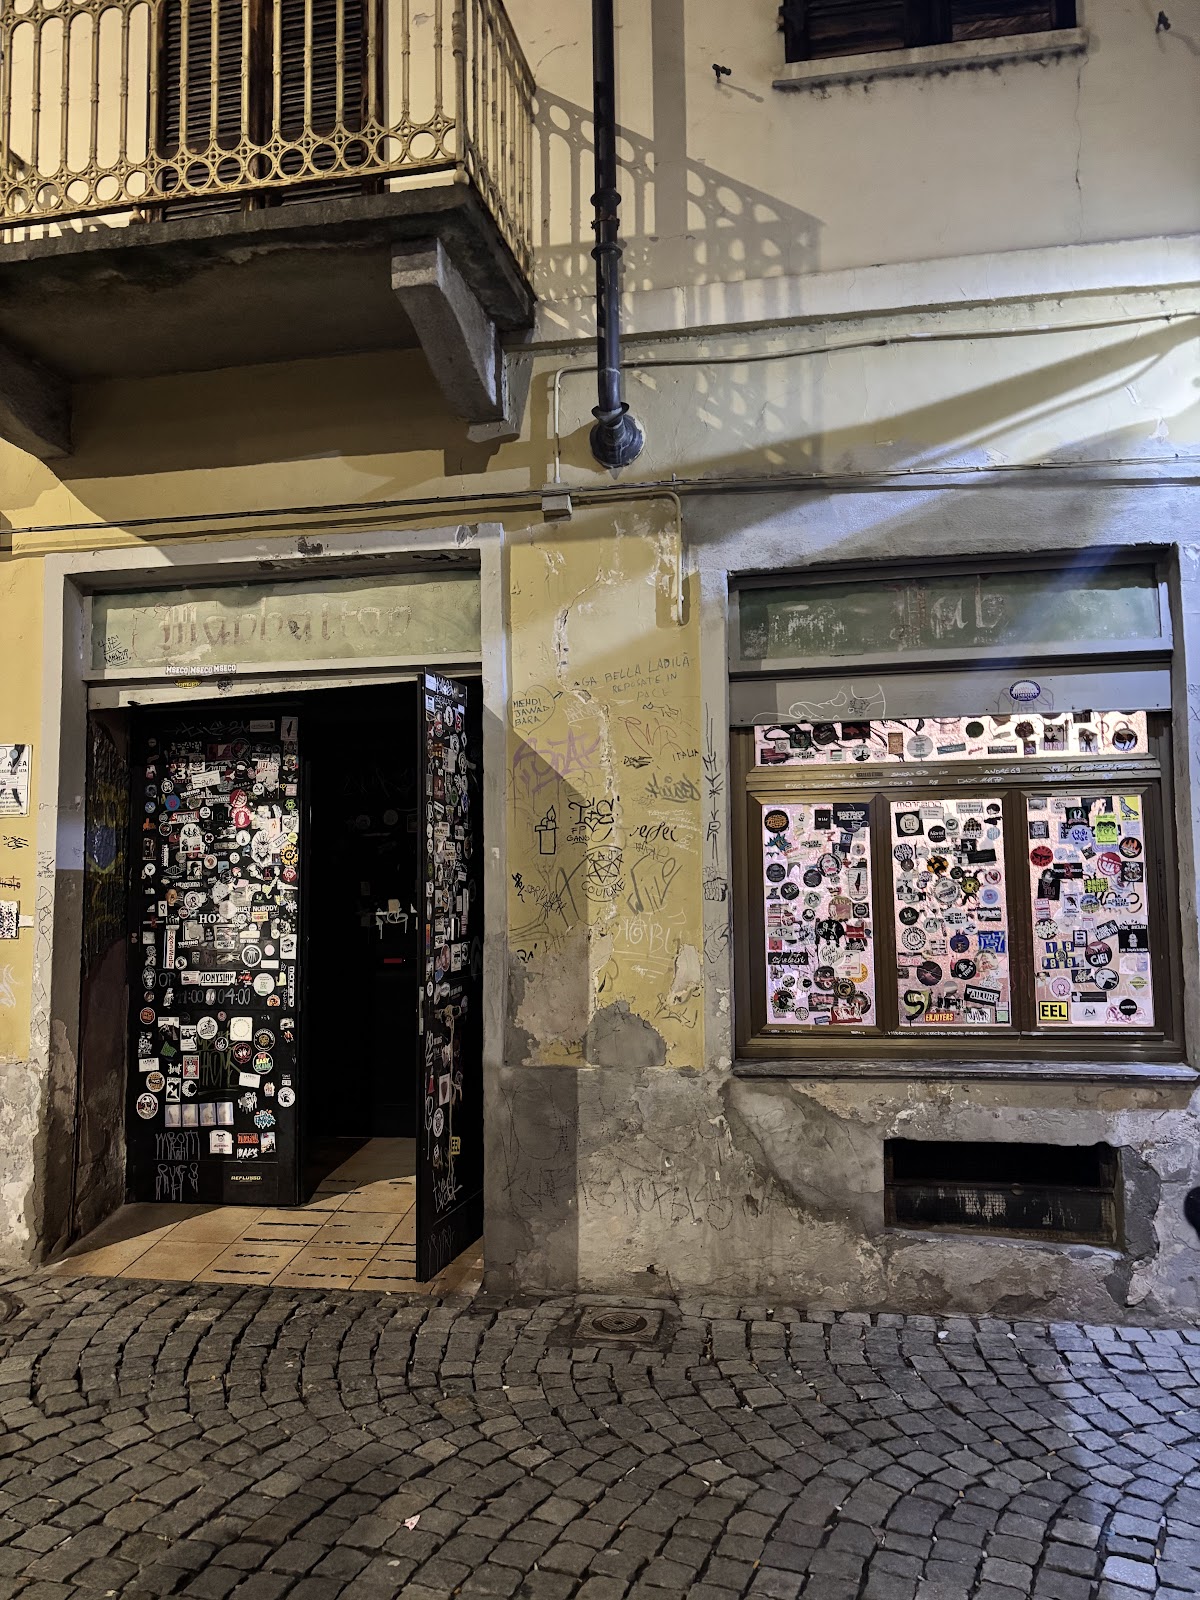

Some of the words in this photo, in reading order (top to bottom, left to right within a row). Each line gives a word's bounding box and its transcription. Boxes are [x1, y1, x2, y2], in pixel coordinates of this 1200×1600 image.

[252, 905, 278, 913] NOBODY
[217, 988, 251, 1005] 04:00
[1041, 1004, 1066, 1018] EEL
